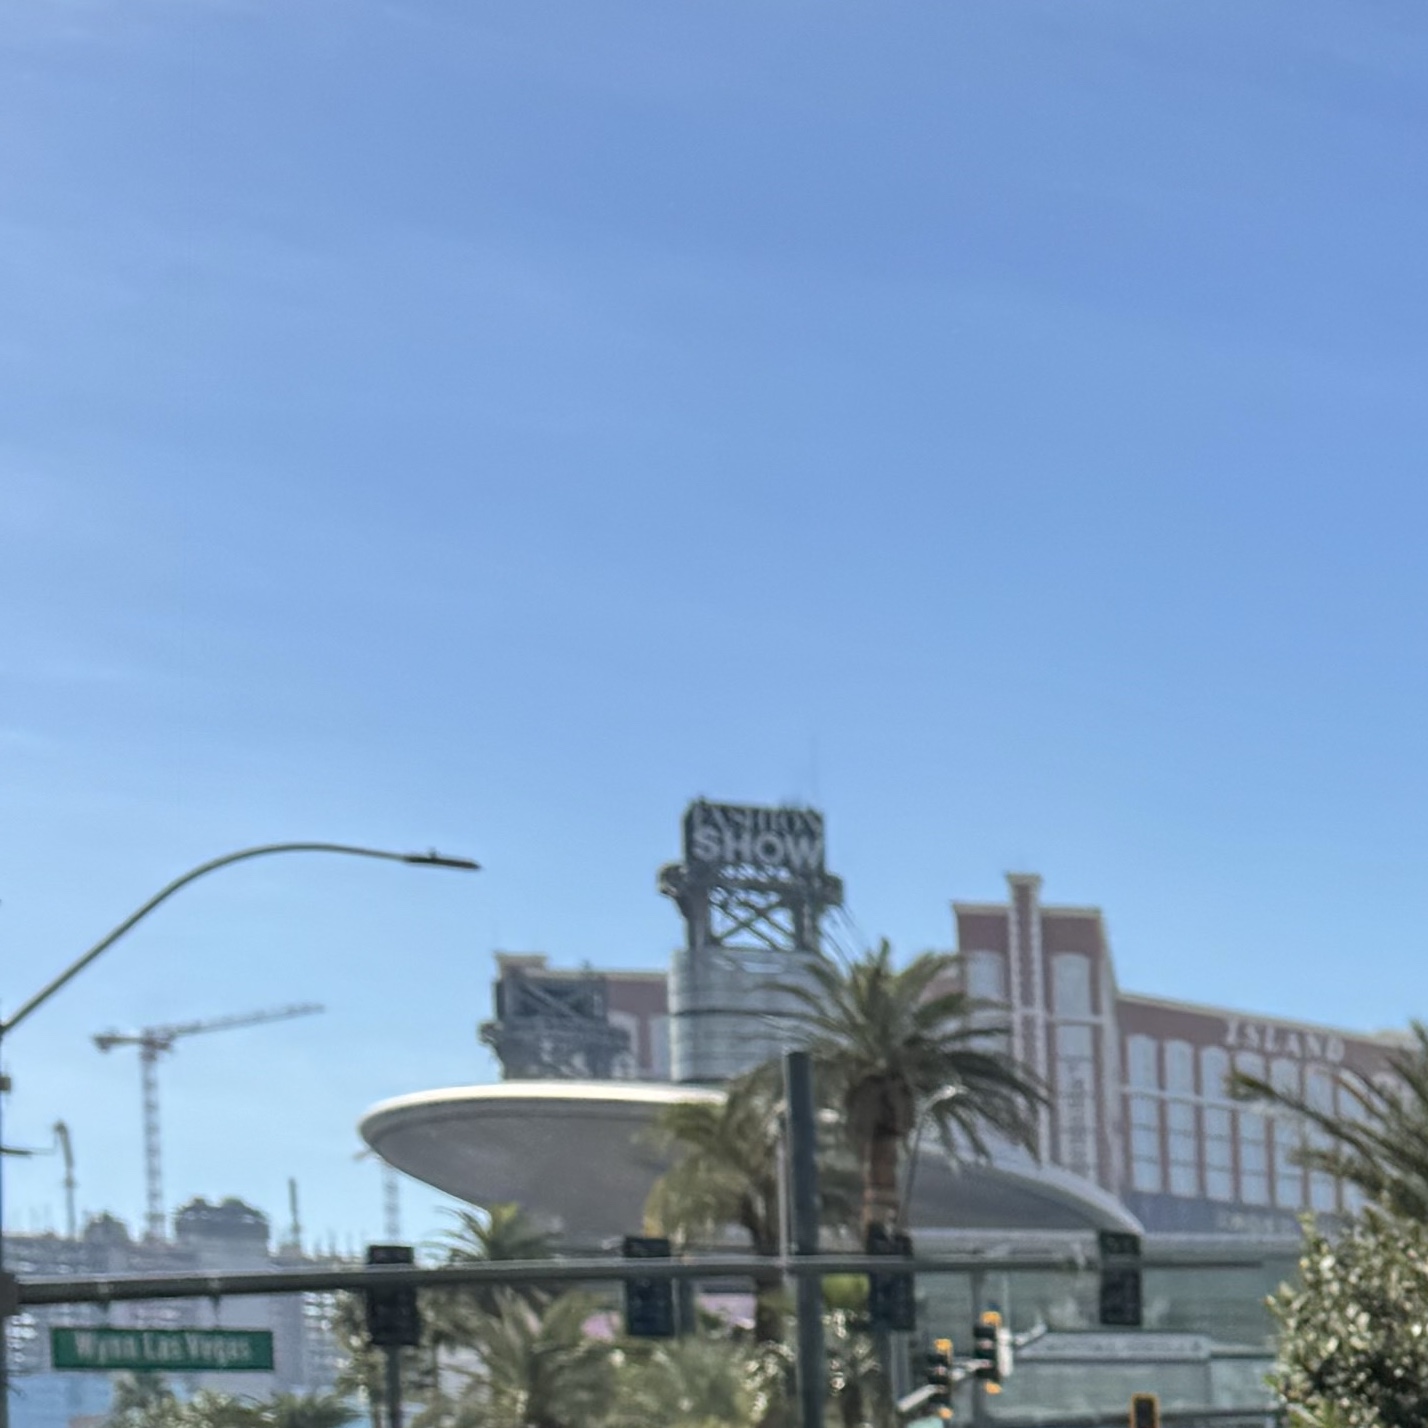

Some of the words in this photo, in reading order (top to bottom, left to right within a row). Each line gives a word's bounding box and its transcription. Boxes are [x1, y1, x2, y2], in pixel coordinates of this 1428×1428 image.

[692, 825, 823, 869] SHOW
[1226, 1017, 1345, 1063] ISLAND
[142, 1331, 183, 1361] Las
[186, 1332, 252, 1367] Vegas
